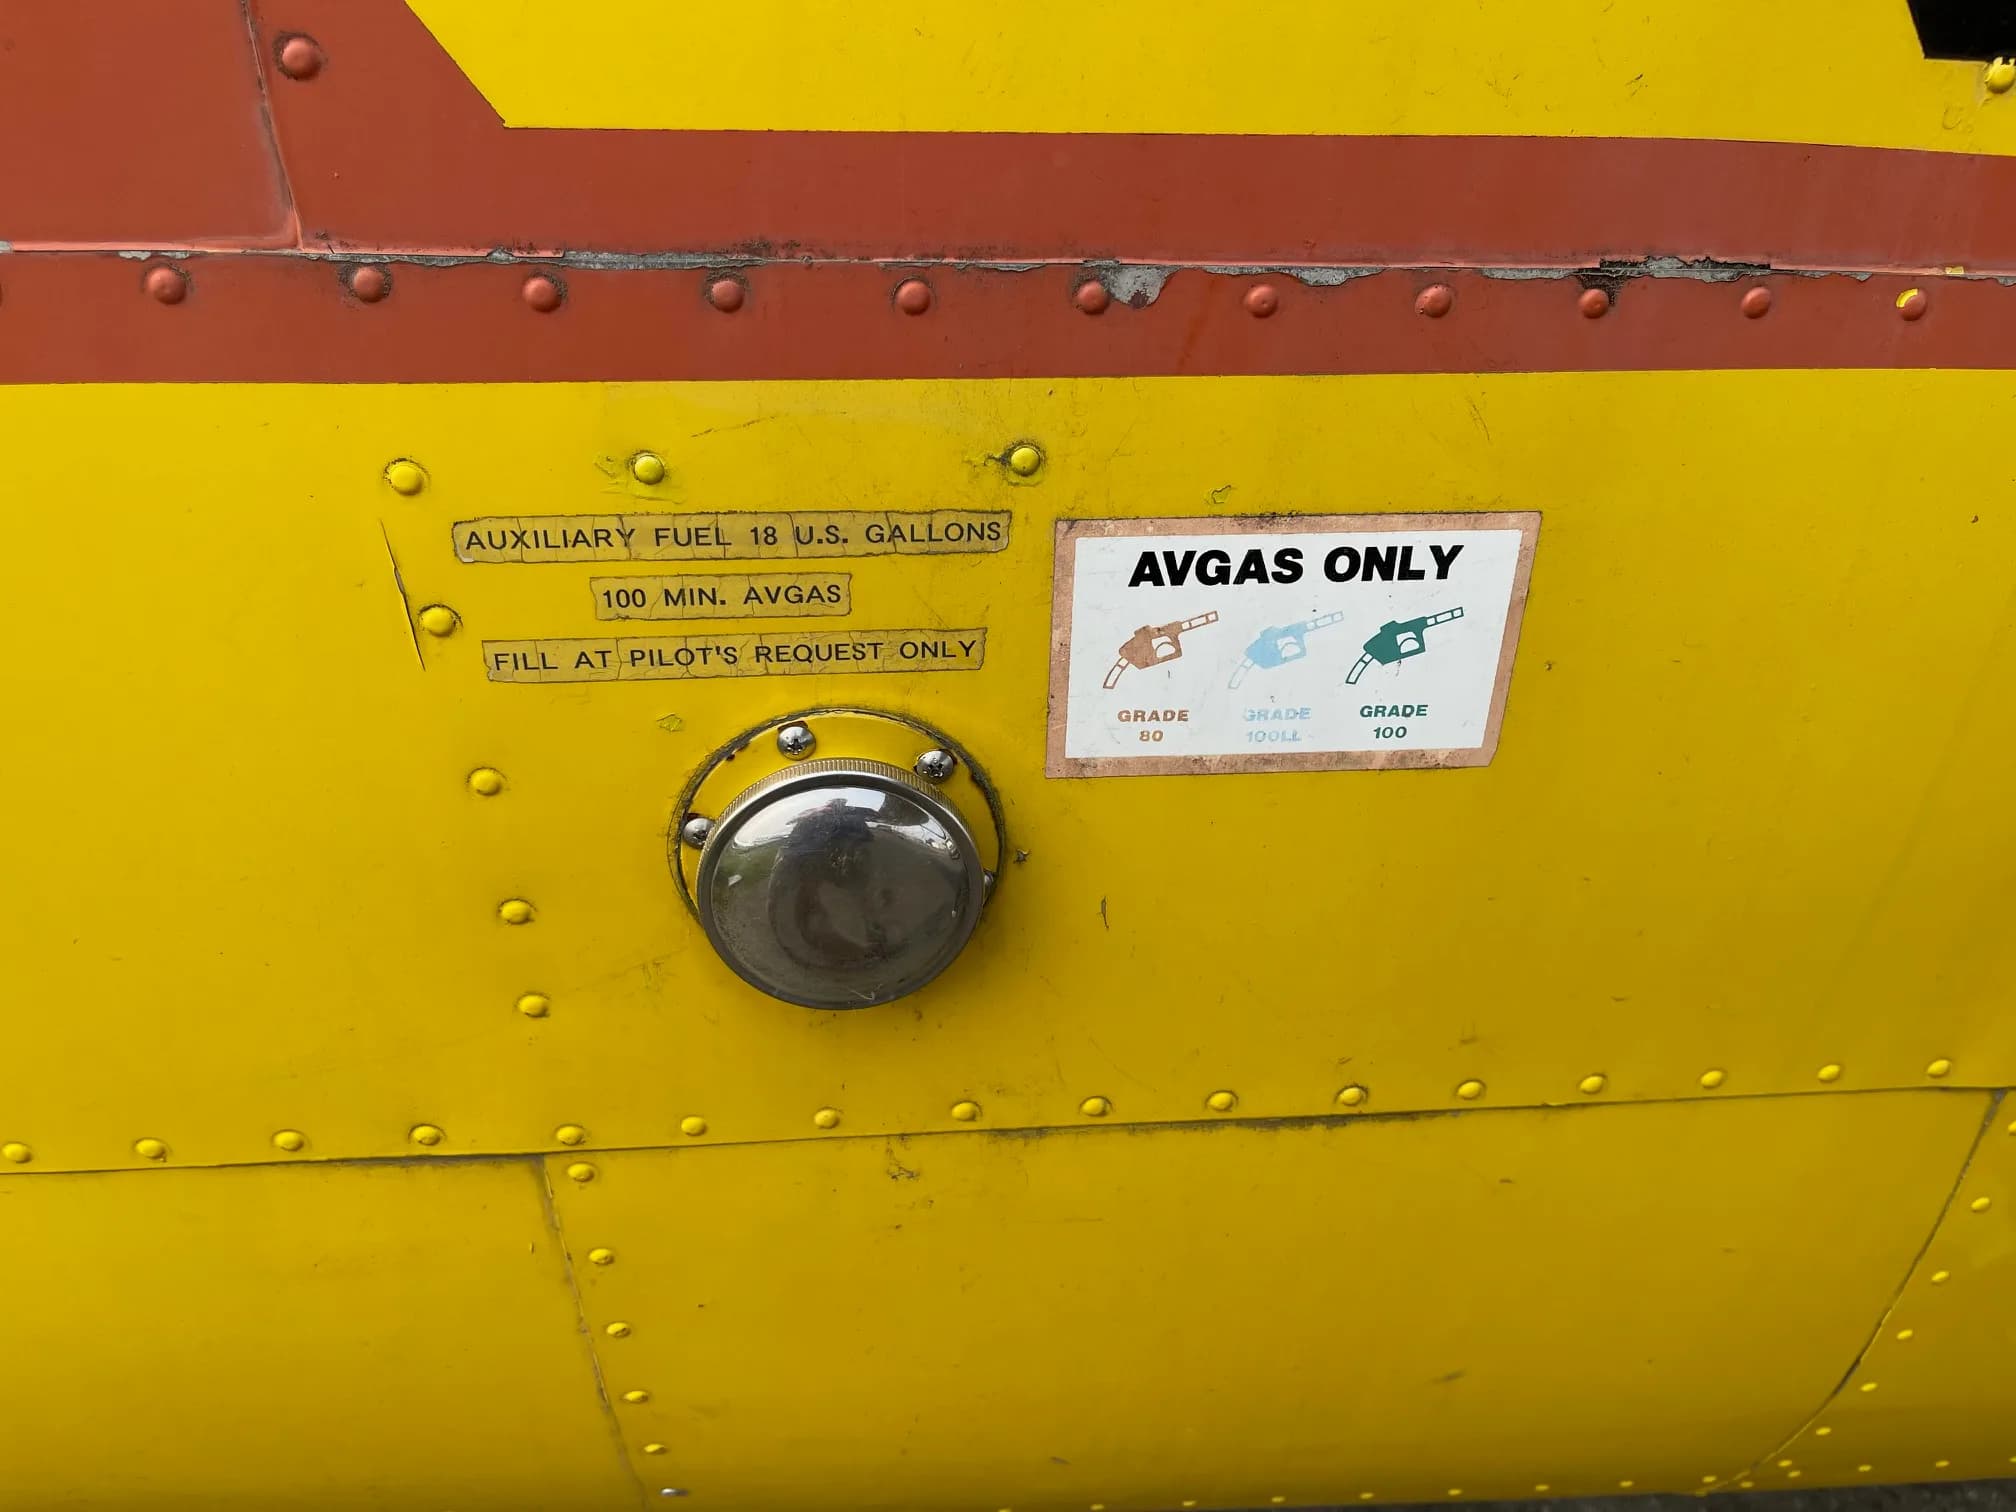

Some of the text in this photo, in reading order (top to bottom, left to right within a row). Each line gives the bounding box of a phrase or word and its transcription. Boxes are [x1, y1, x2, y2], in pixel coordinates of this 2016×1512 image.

[466, 521, 1001, 550] AUXILIARY FUEL 18 U.S. GALLONS
[1128, 545, 1464, 587] AVGAS ONLY
[602, 584, 842, 609] 100 MIN. AVGAS
[493, 639, 977, 672] FILL AT PILOT'S REQUEST ONLY
[1117, 709, 1190, 723] GRADE
[1242, 707, 1312, 722] GRADE
[1359, 705, 1429, 718] GRADE
[1138, 730, 1164, 743] 80
[1246, 730, 1302, 743] 100LL
[1372, 726, 1407, 739] 100
